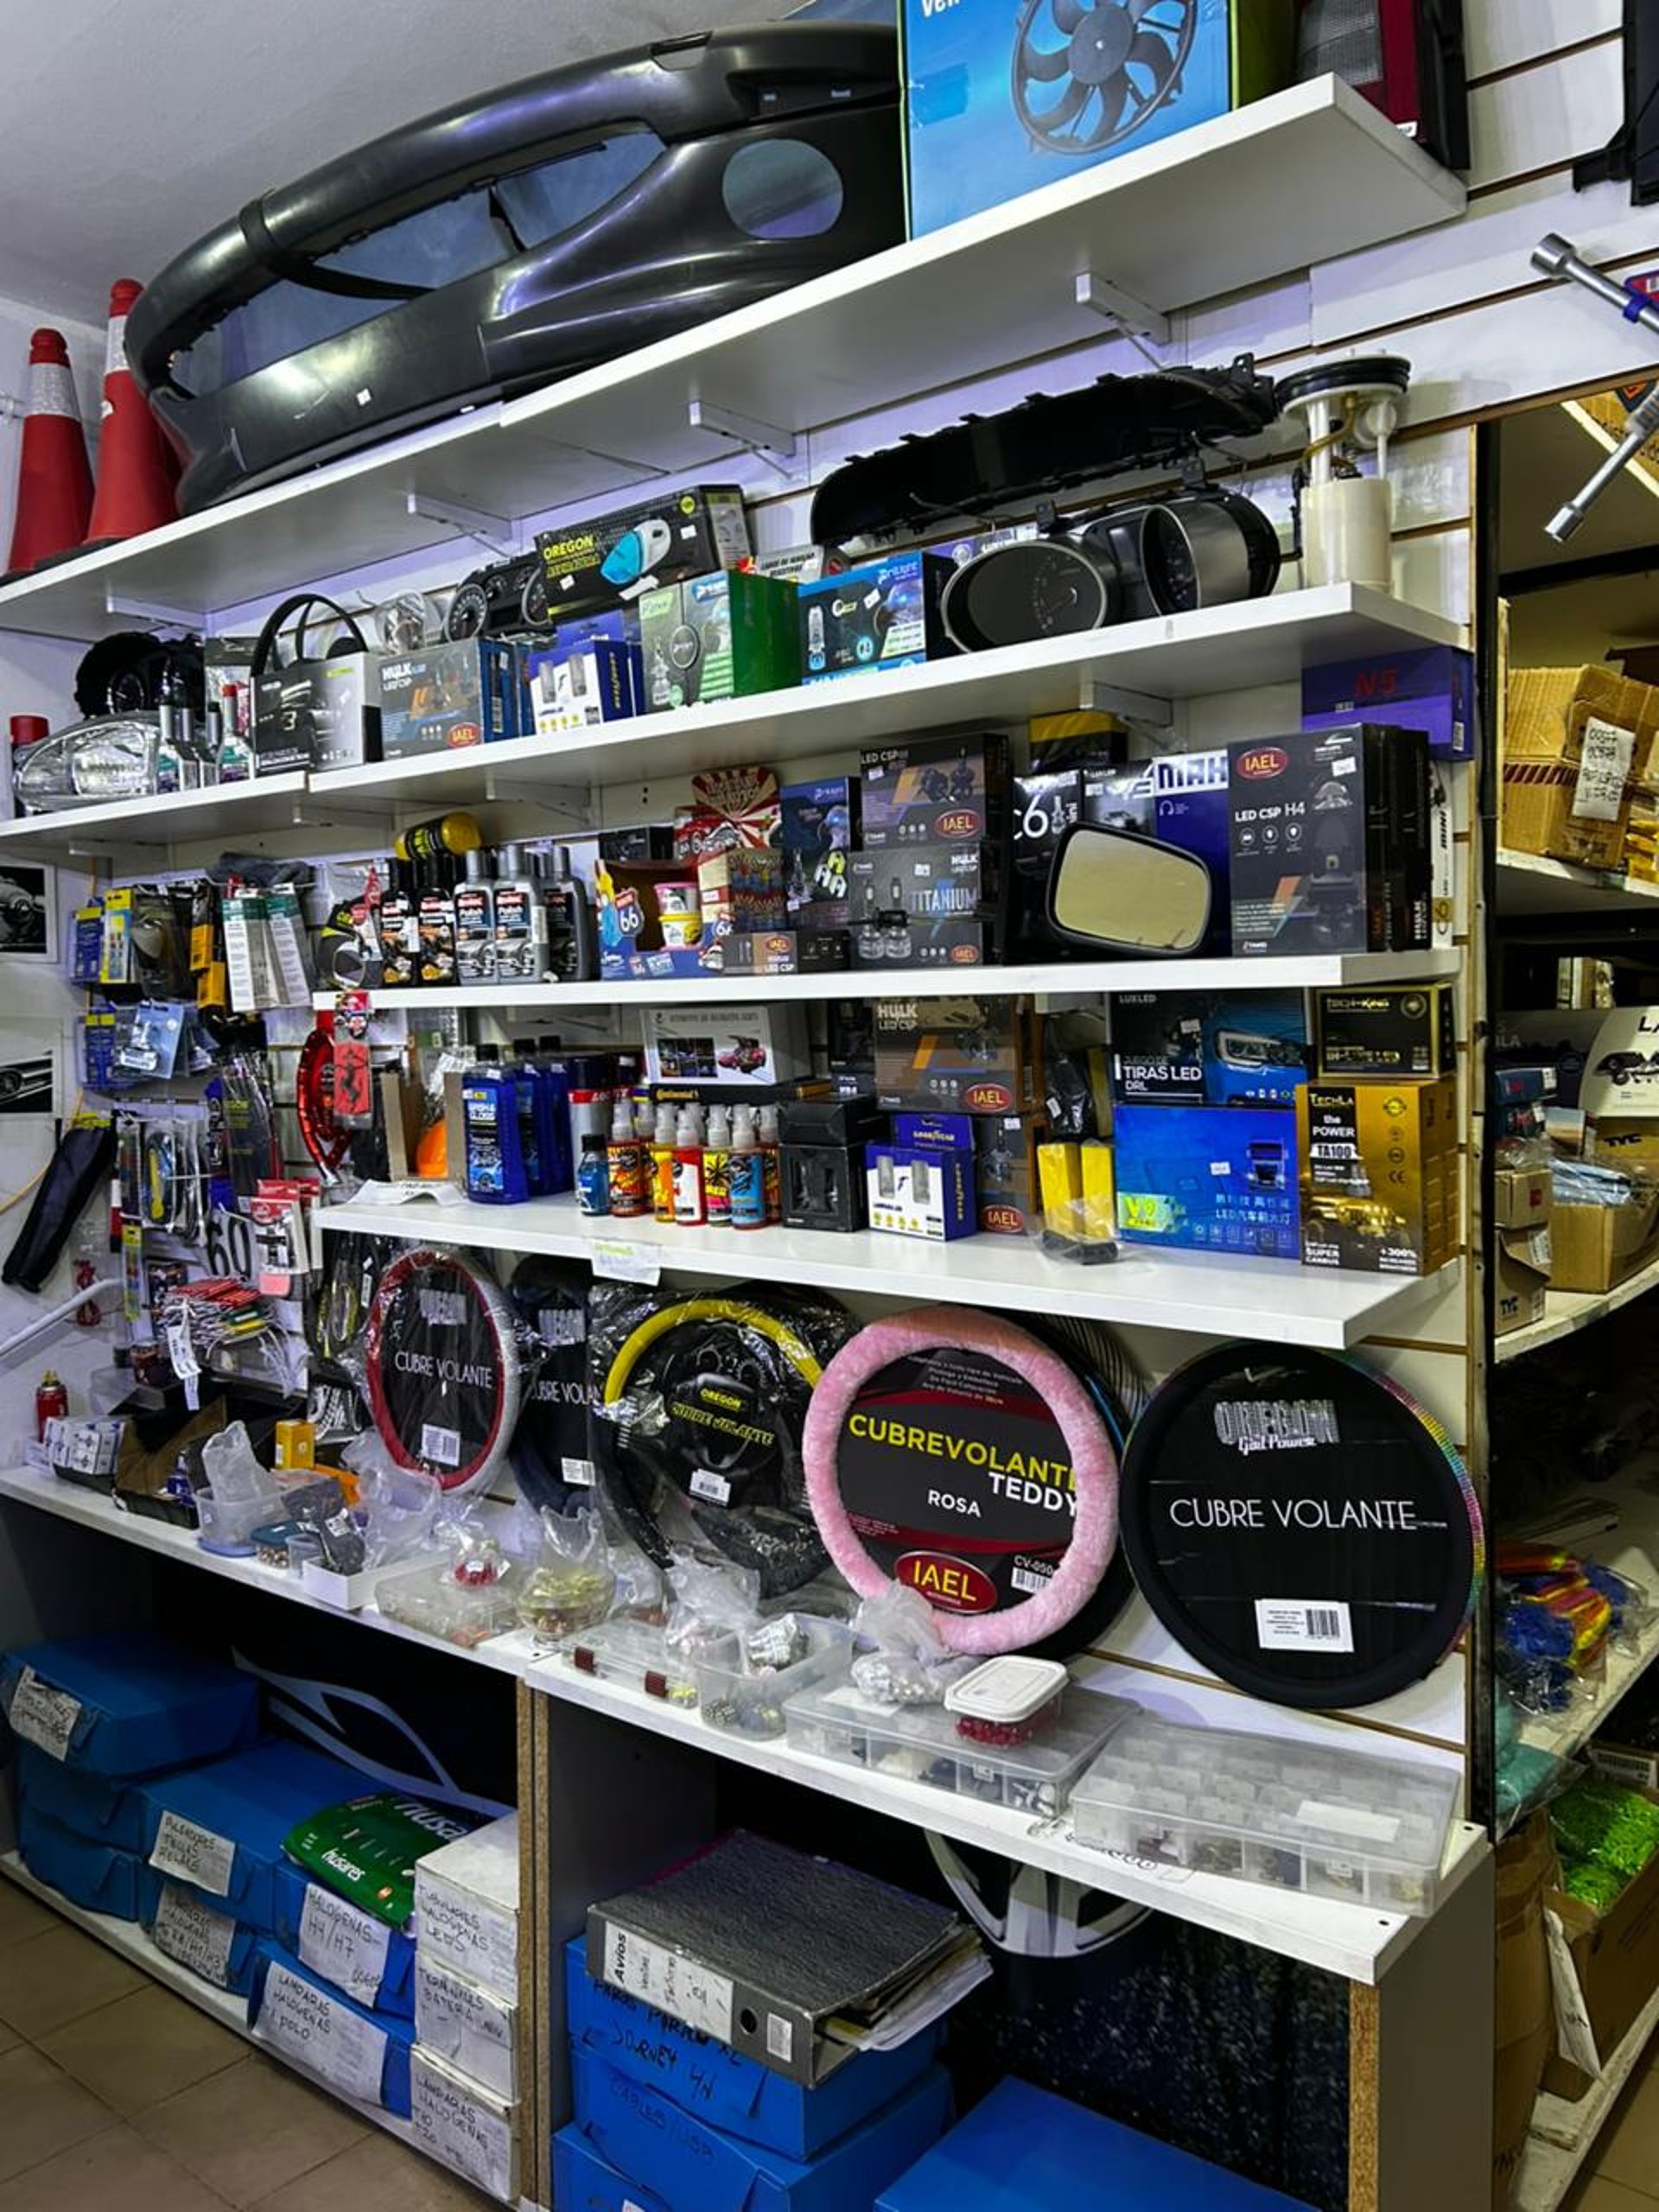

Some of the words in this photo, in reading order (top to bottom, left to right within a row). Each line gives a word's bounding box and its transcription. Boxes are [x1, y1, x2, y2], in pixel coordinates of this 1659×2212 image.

[543, 535, 594, 560] OREGON
[451, 728, 474, 743] IAEL
[861, 752, 879, 764] LED
[880, 749, 899, 761] CSP
[1245, 753, 1280, 771] IAEL
[1235, 810, 1257, 822] LED
[1259, 806, 1282, 819] CSP
[1284, 801, 1306, 817] H4
[942, 815, 975, 831] IAEL
[912, 887, 977, 913] TITANIUM
[620, 909, 640, 932] 66
[877, 1003, 918, 1018] HULK
[1123, 1065, 1168, 1080] TIRAS
[1171, 1066, 1202, 1080] LED
[1126, 1081, 1148, 1092] DRL
[973, 1089, 1006, 1104] IAEL
[1324, 1115, 1341, 1124] the
[1313, 1126, 1355, 1137] POWER
[1317, 1145, 1352, 1157] TA100
[988, 1216, 1020, 1231] IAEL
[1306, 1248, 1339, 1257] SUPER
[395, 1351, 433, 1376] CUBRE
[435, 1358, 493, 1389] VOLANTE
[928, 1489, 982, 1518] ROSA
[1169, 1498, 1265, 1529] CUBRE
[1271, 1499, 1419, 1530] VOLANTE
[913, 1560, 978, 1602] IAEL
